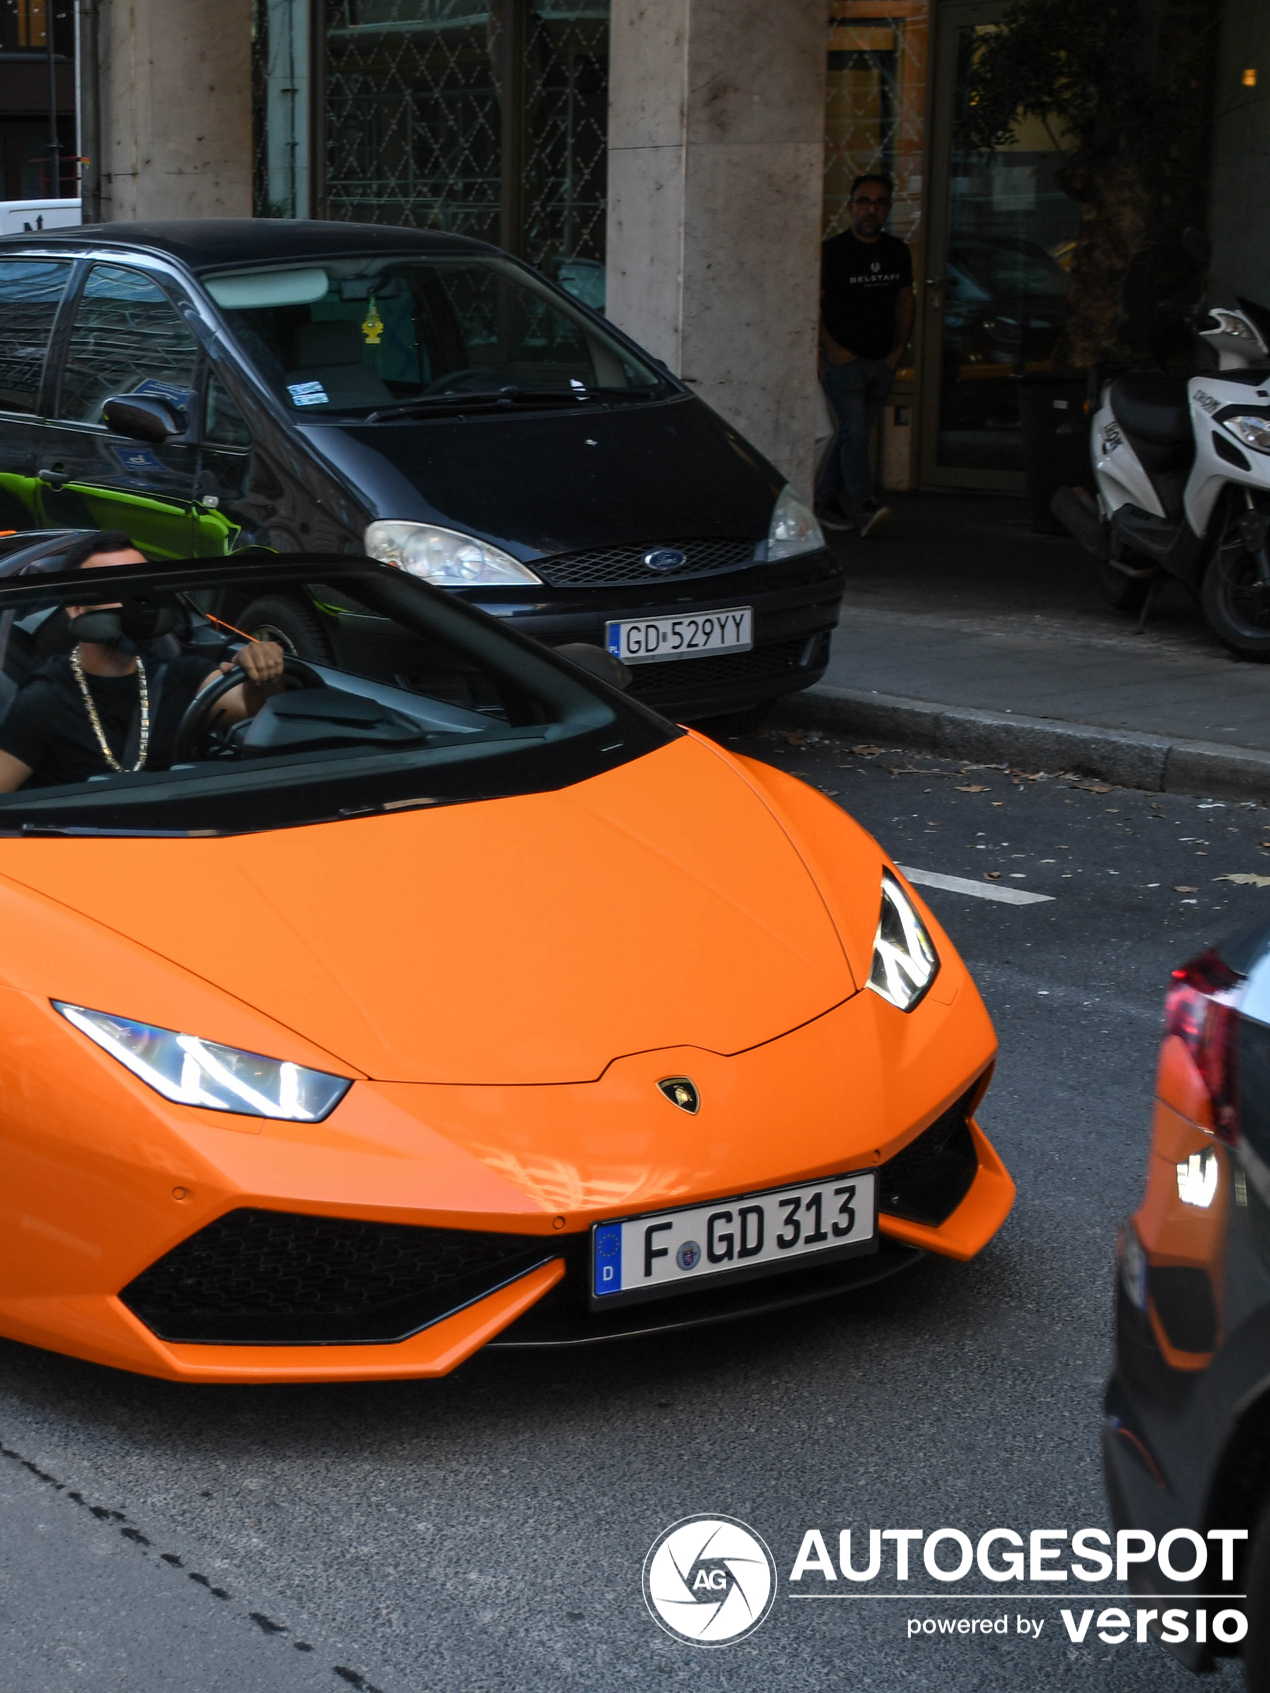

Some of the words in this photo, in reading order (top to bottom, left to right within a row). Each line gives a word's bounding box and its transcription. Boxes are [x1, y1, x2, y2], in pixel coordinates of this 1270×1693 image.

[626, 624, 660, 655] GD
[671, 613, 745, 651] 529YY
[602, 1265, 614, 1282] D
[643, 1221, 673, 1278] F
[706, 1204, 765, 1264] GD
[776, 1174, 857, 1250] 313
